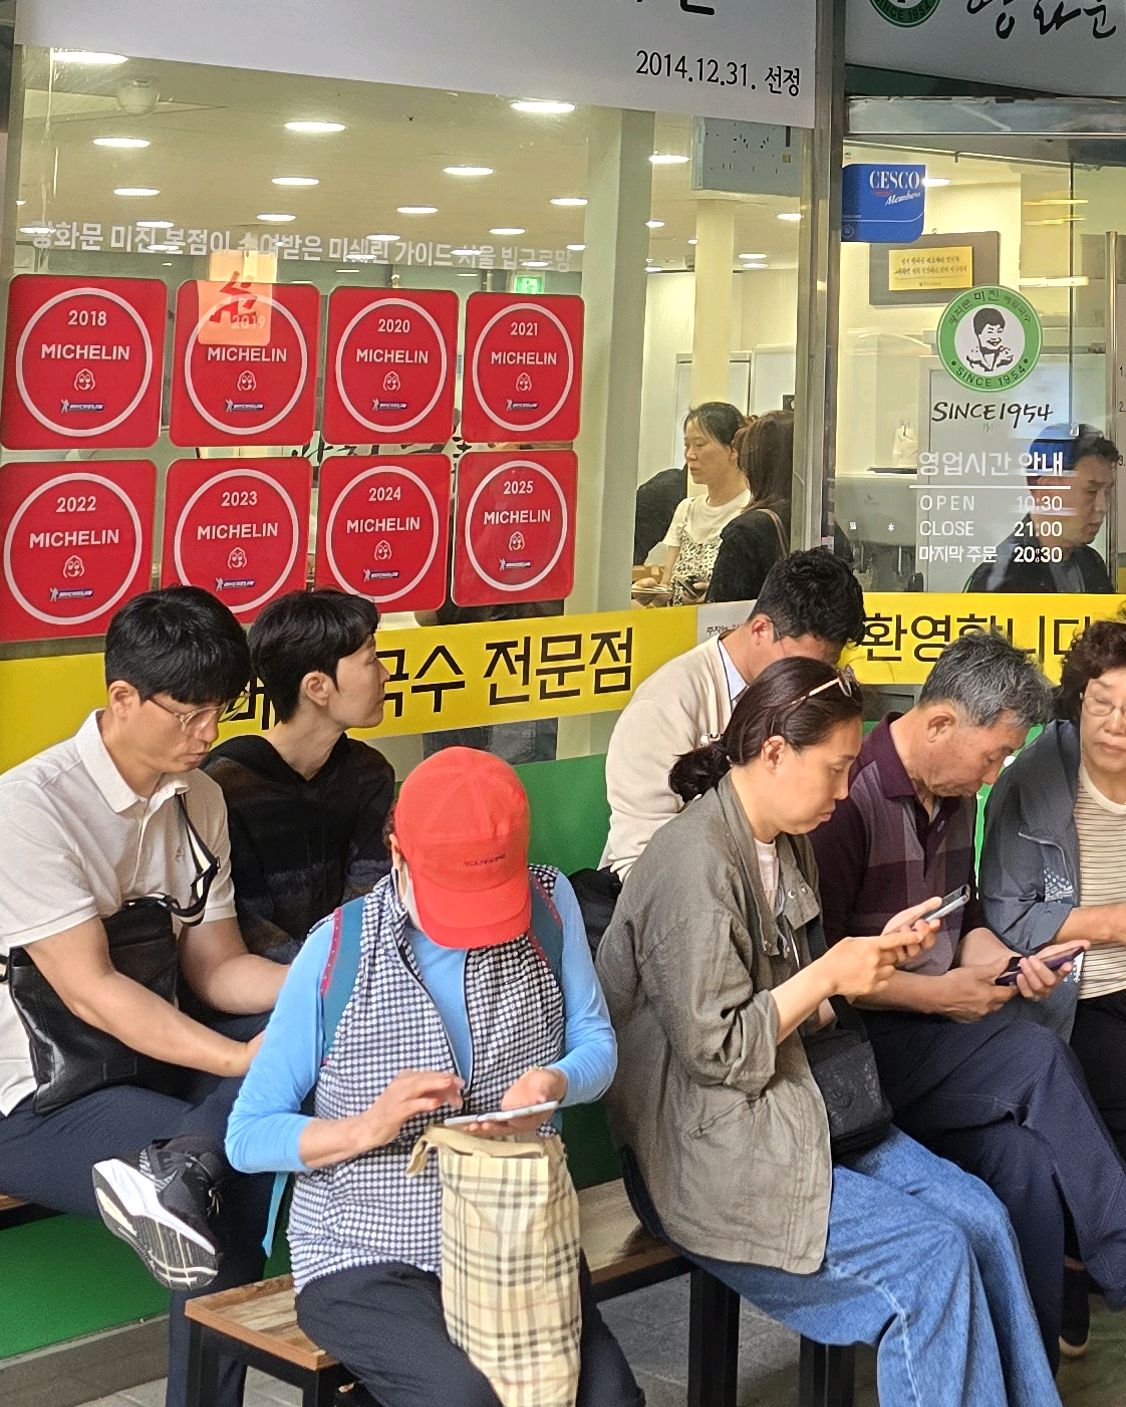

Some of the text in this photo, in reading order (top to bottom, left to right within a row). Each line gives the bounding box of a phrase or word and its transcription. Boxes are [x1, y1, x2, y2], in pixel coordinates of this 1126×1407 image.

[636, 50, 800, 97] 2014.12.31. 선정
[869, 170, 920, 189] CESCO
[111, 225, 157, 253] 미진
[166, 227, 230, 256] 본점이
[395, 242, 453, 267] 가이드
[973, 290, 1000, 303] 미진
[67, 310, 107, 327] 2018
[378, 319, 410, 333] 2020
[510, 322, 538, 336] 2021
[41, 344, 130, 361] MICHELIN
[207, 346, 287, 363] MICHELIN
[356, 348, 429, 364] MICHELIN
[491, 351, 557, 366] MICHELIN
[955, 365, 1026, 387] SINCE 1954
[919, 451, 1063, 477] 영업시간 안내
[368, 486, 402, 502] 2024
[503, 480, 534, 495] 2025
[55, 496, 97, 513] 2022
[221, 491, 258, 507] 2023
[919, 495, 1063, 511] OPEN 10:30
[346, 516, 421, 534] MICHELIN
[483, 509, 551, 525] MICHELIN
[197, 522, 278, 541] MICHELIN
[919, 520, 1063, 537] CLOSE 21:00
[29, 528, 120, 549] MICHELIN
[919, 546, 1063, 564] 마지막 주문 20:30
[484, 626, 635, 703] 전문점
